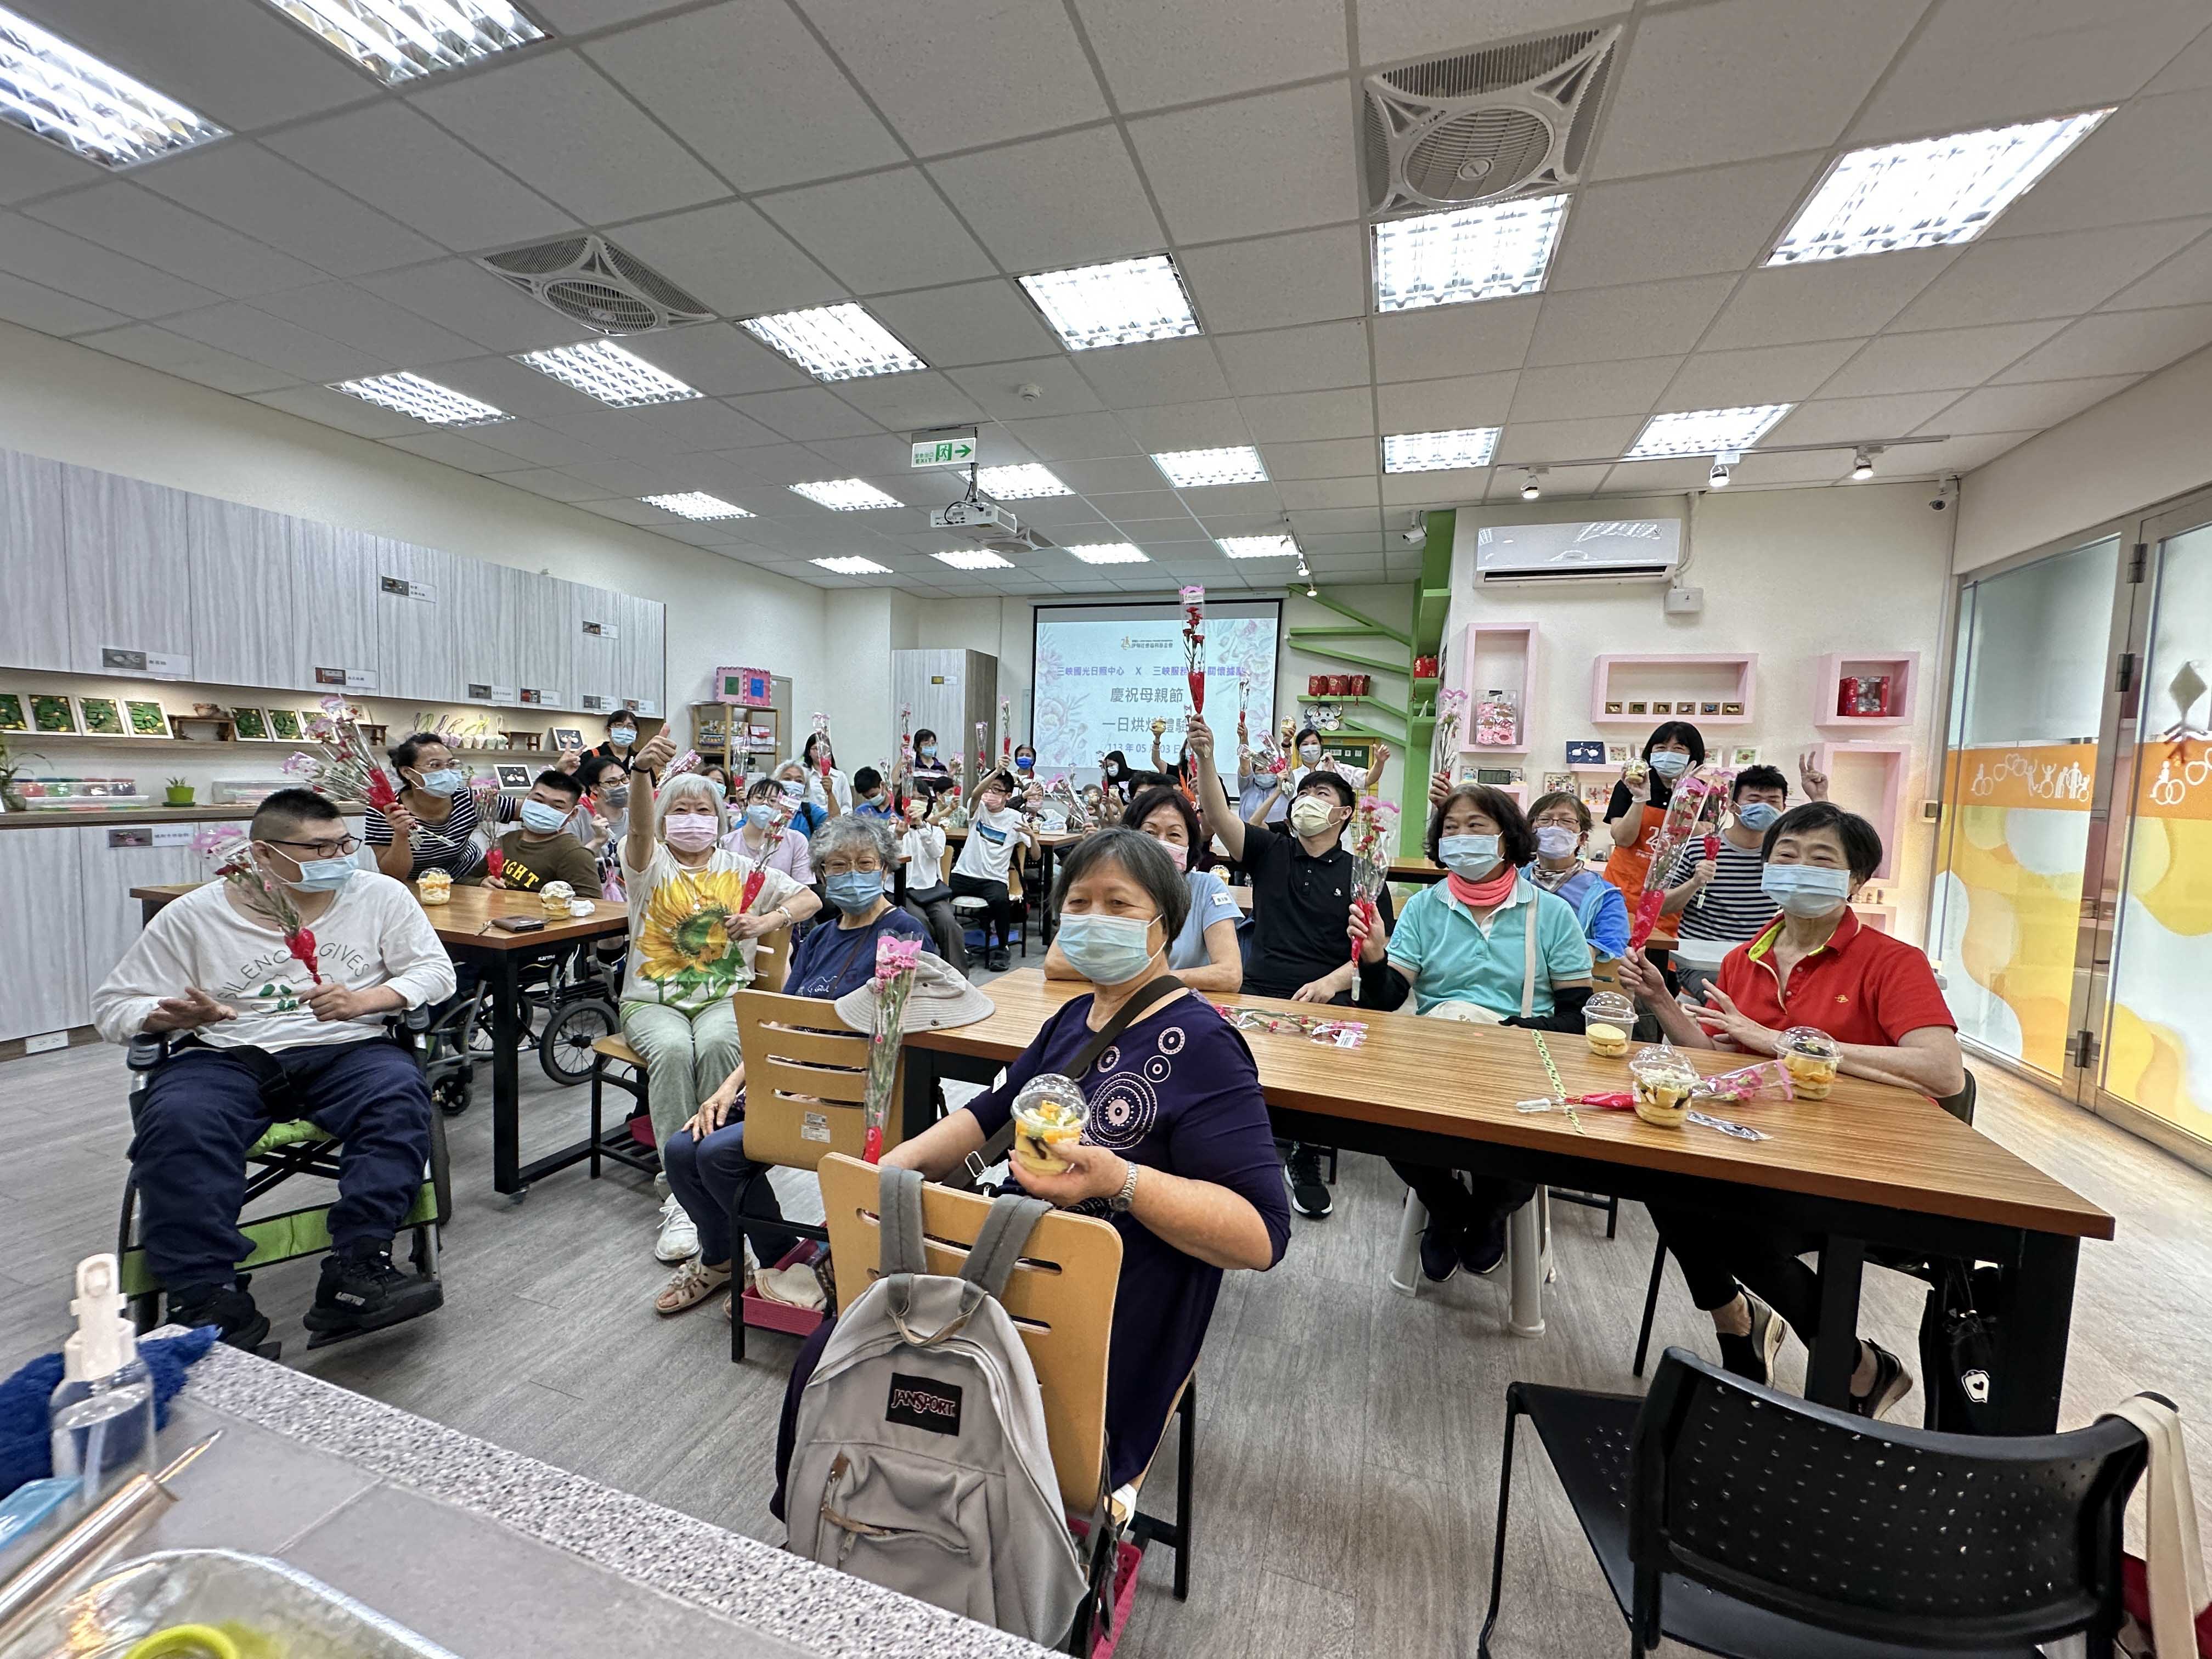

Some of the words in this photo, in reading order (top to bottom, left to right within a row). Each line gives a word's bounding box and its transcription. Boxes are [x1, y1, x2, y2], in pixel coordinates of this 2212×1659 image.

[1057, 667, 1125, 676] 三峽國光日照中心
[1135, 667, 1142, 675] X
[1110, 687, 1183, 703] 慶祝母親節
[501, 859, 539, 888] IGHT
[218, 949, 290, 998] SILENC
[319, 942, 370, 977] GIVES
[891, 1389, 956, 1417] JANSPORT
